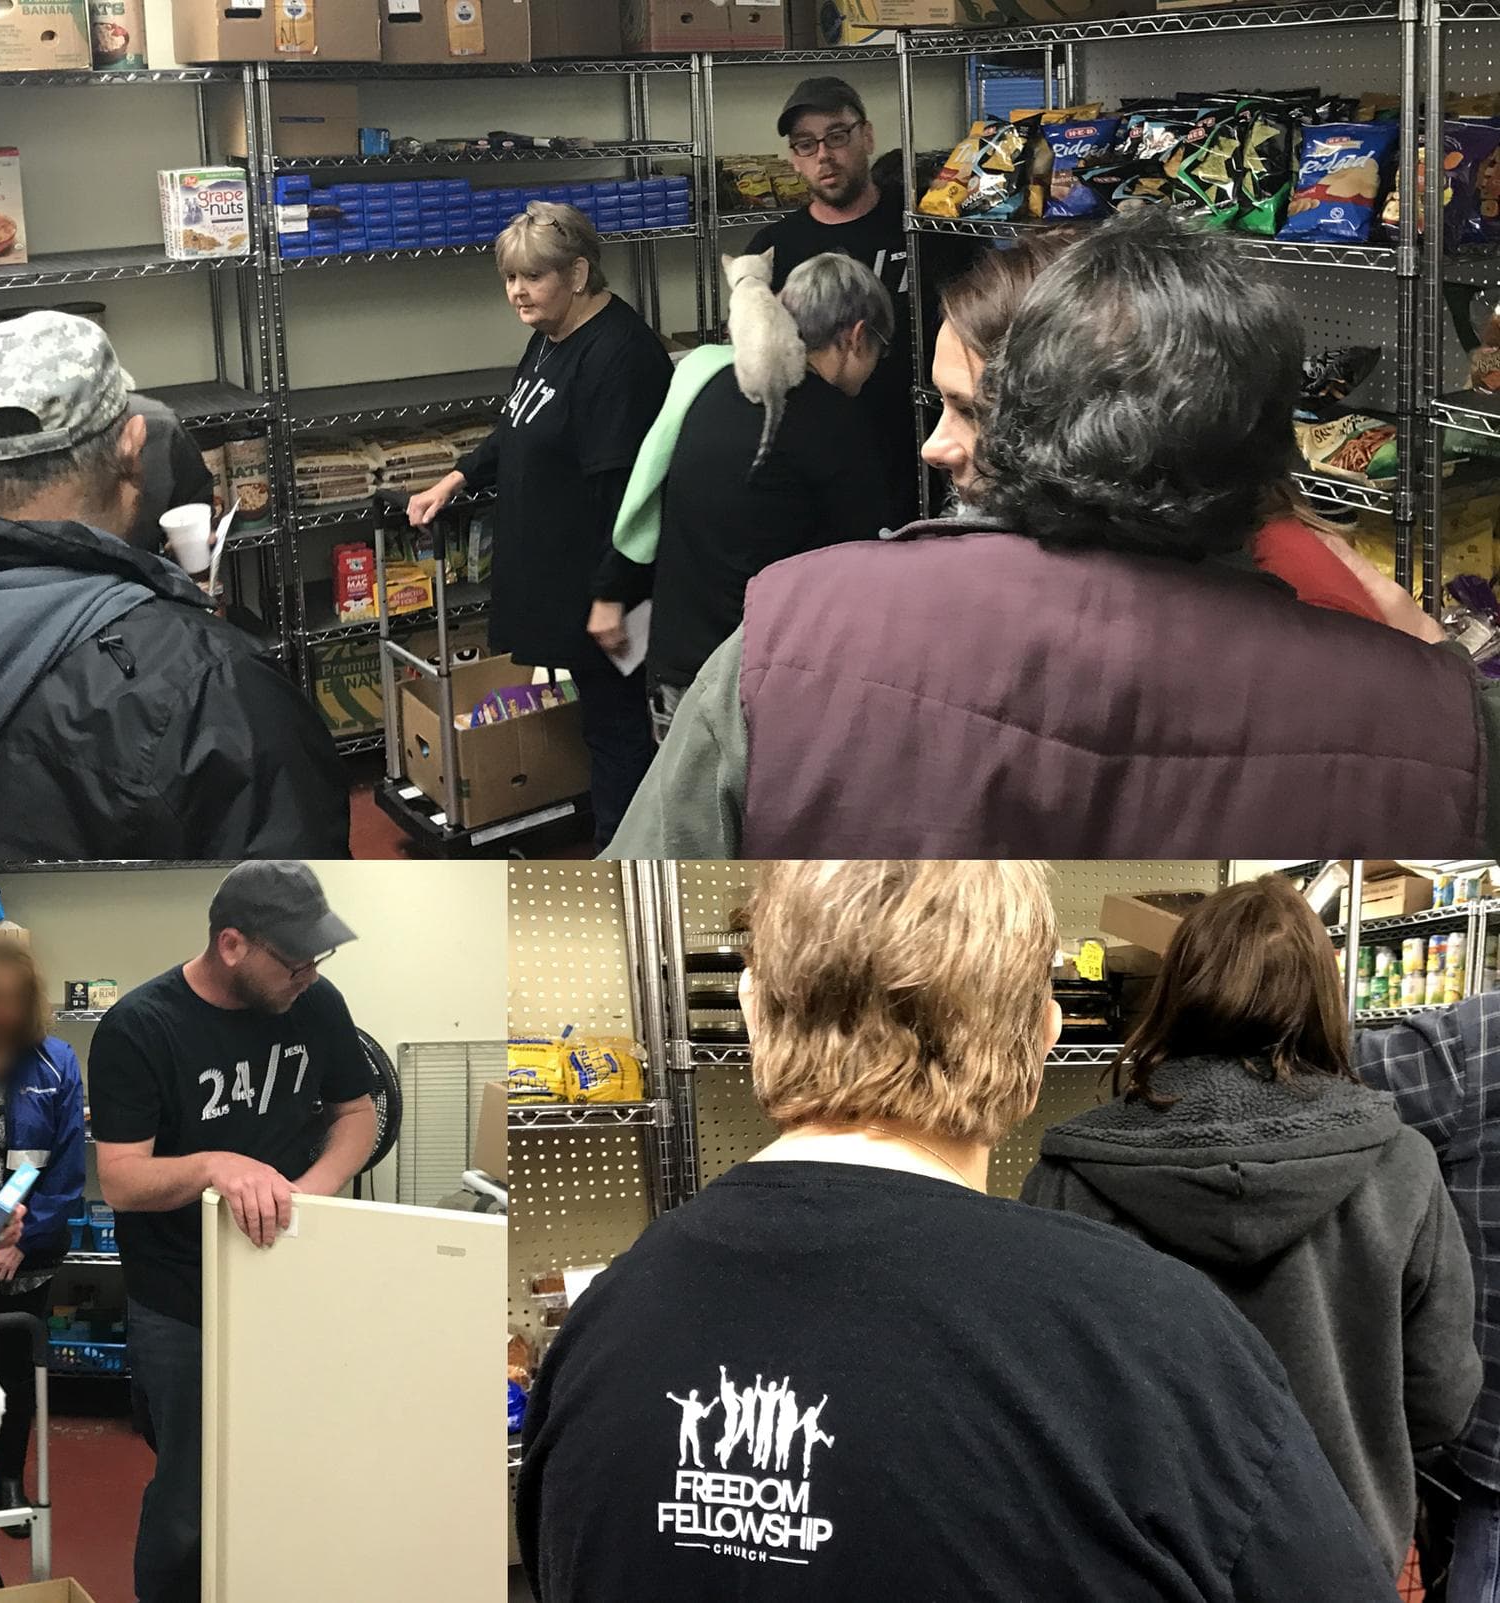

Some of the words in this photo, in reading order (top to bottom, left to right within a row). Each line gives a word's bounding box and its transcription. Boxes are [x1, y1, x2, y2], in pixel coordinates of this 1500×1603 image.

[91, 2, 125, 16] ATS
[198, 190, 244, 209] grape
[283, 1044, 307, 1058] JESU
[199, 1043, 310, 1118] 24/7
[201, 1103, 231, 1121] JESUS
[675, 1470, 810, 1514] FREEDOM
[658, 1502, 833, 1551] FELLOWSHIP
[713, 1543, 767, 1562] CHURCH
